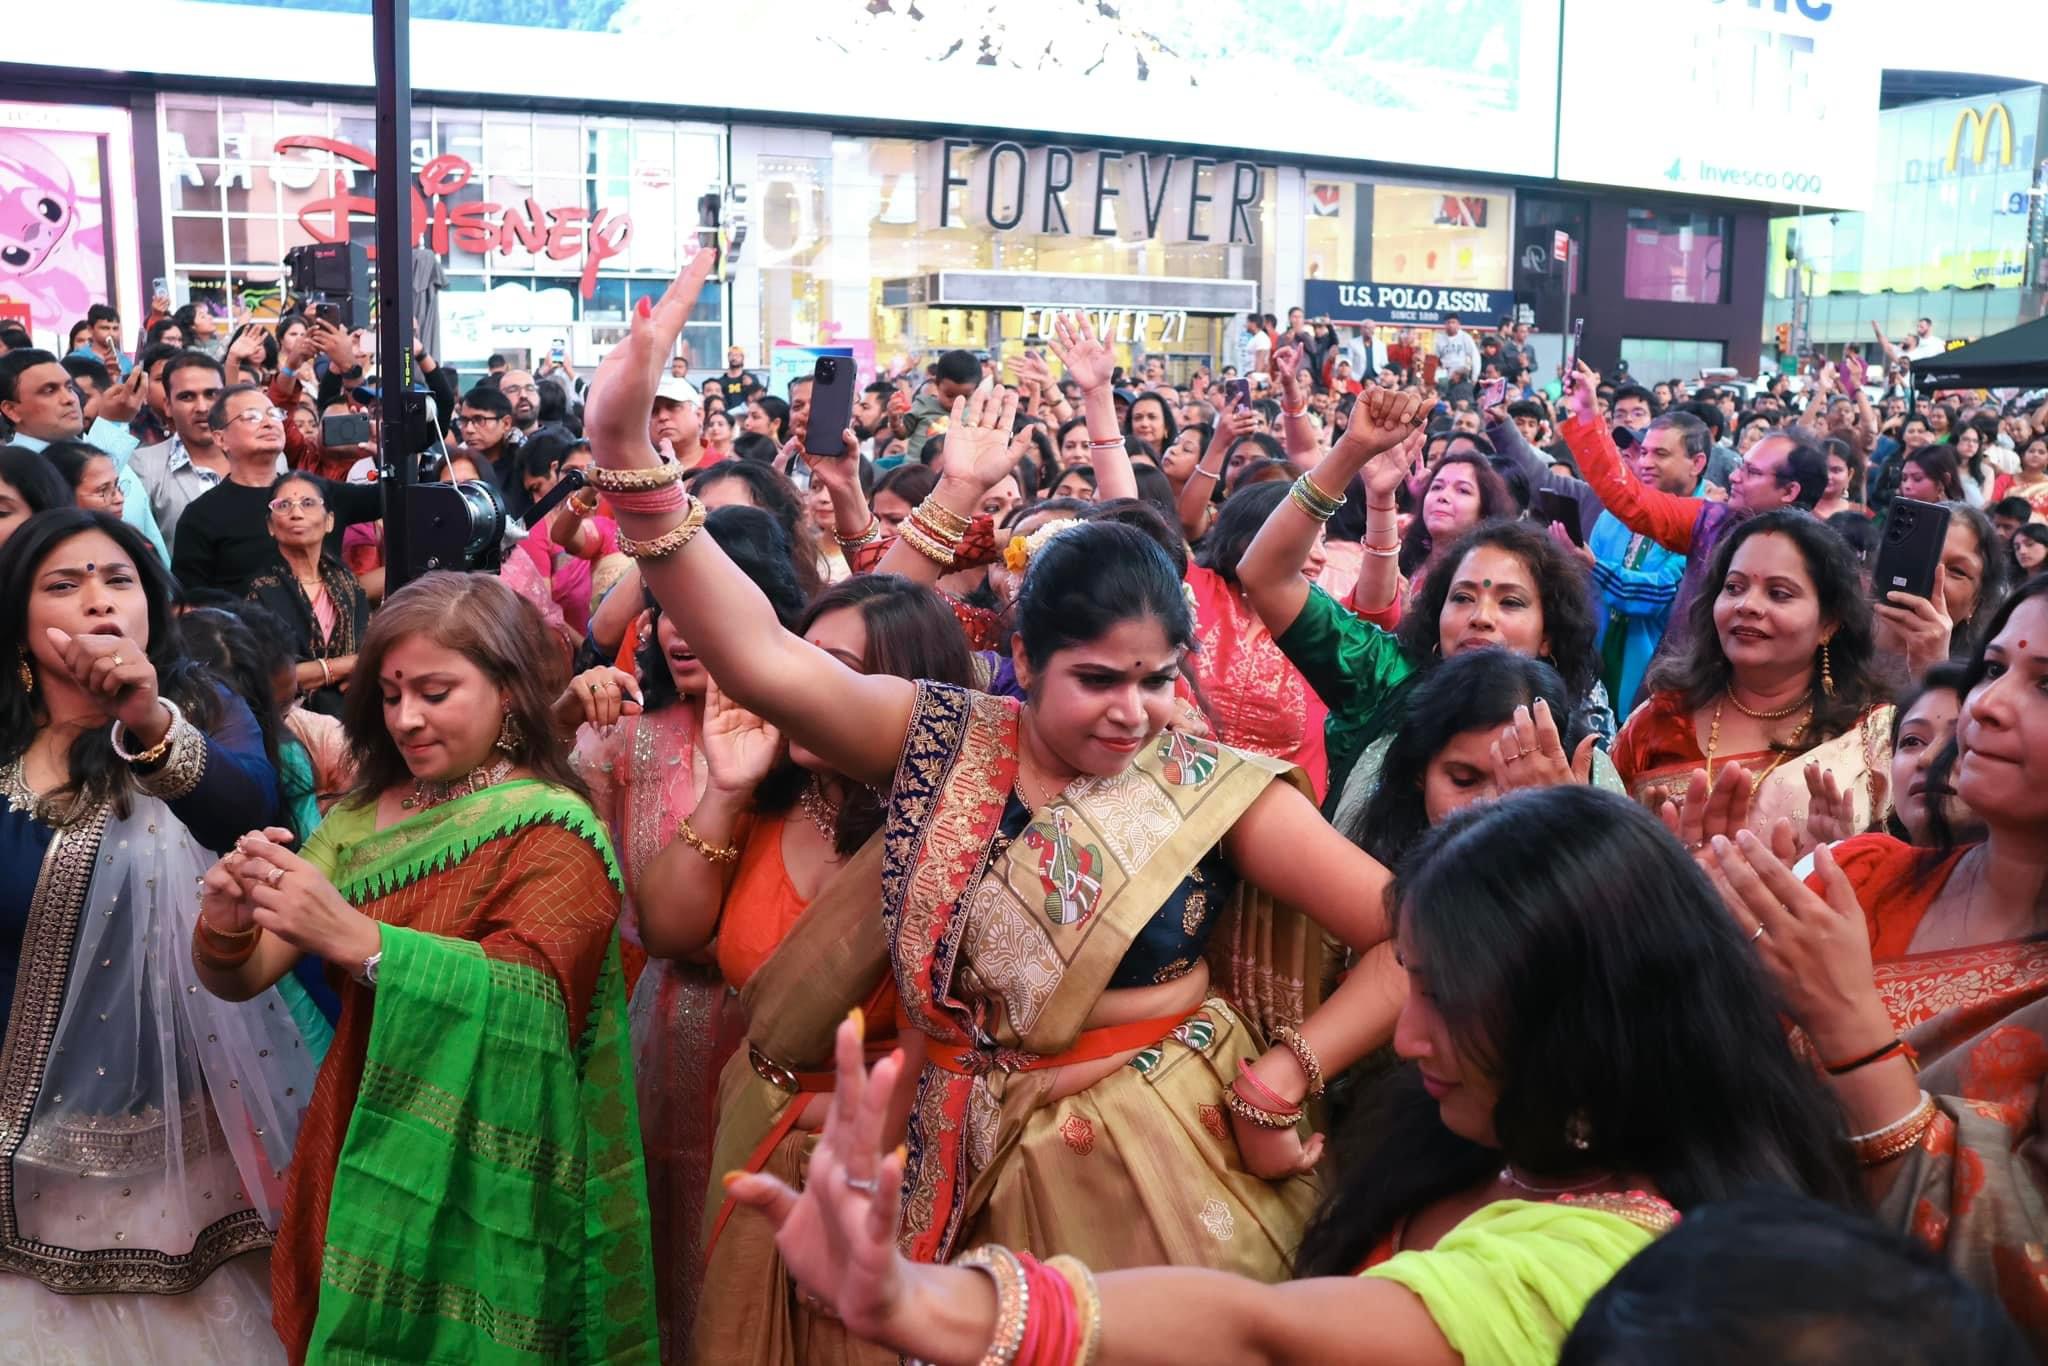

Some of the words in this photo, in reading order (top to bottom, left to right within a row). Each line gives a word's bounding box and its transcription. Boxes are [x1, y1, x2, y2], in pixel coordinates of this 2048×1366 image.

[1699, 160, 1777, 189] Invesco
[939, 137, 1258, 245] FOREVER
[1339, 285, 1375, 308] U.S.
[1377, 287, 1433, 311] POLO
[1435, 290, 1492, 313] ASSN.
[1161, 311, 1187, 343] 21
[1390, 310, 1417, 321] SINCE
